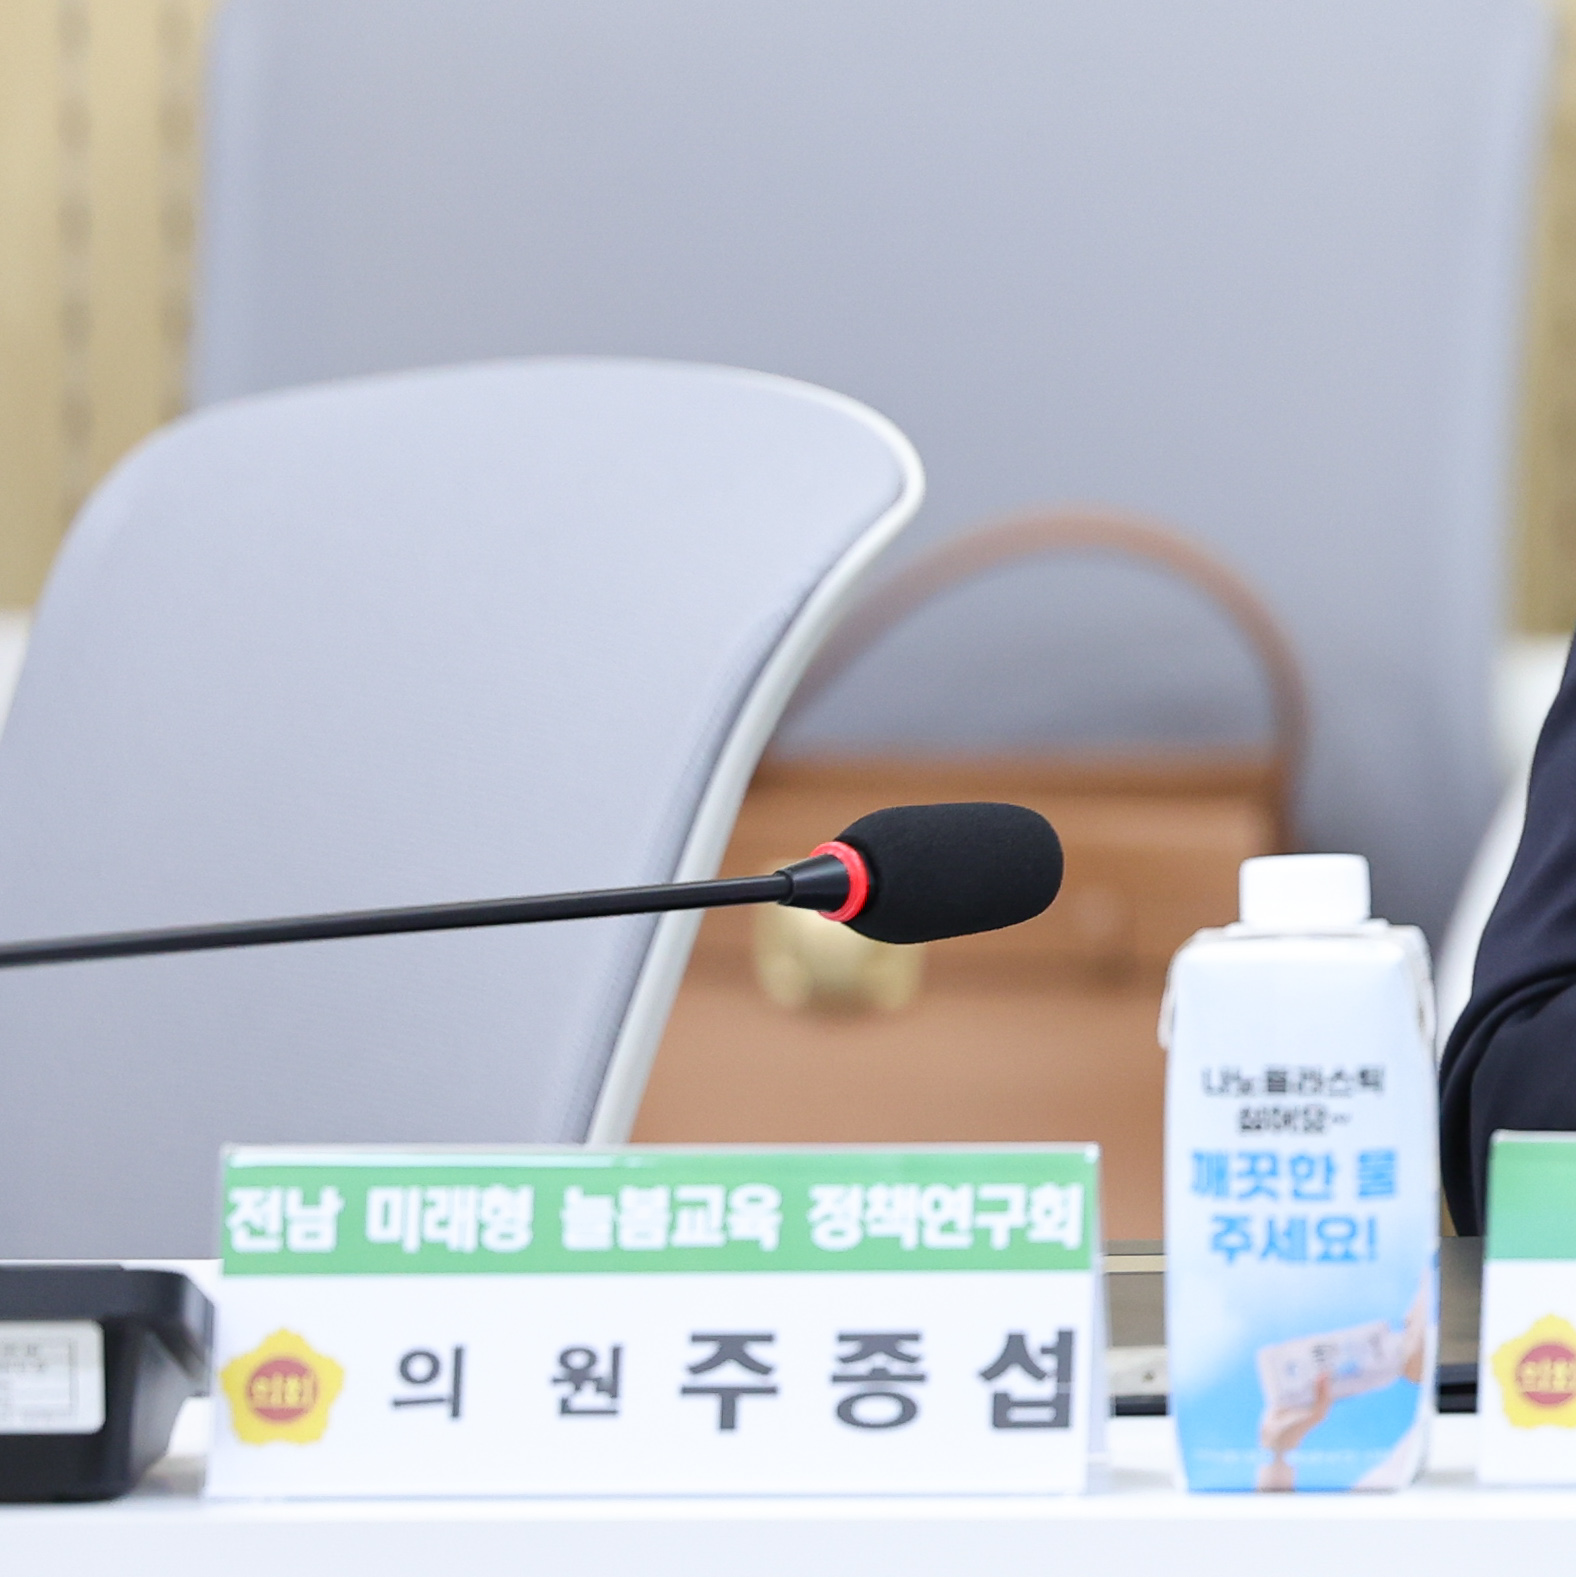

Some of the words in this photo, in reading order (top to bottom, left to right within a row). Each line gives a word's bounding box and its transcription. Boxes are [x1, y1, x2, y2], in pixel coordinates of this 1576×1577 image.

[1192, 1149, 1337, 1201] 깨끗한
[1357, 1149, 1397, 1200] 물
[228, 1186, 345, 1253] 전남
[365, 1184, 534, 1254] 미래형
[561, 1184, 783, 1252] 늘봄교육
[807, 1182, 1083, 1251] 정책연구회
[1210, 1214, 1379, 1264] 주세요!
[680, 1327, 1078, 1432] 주종섭
